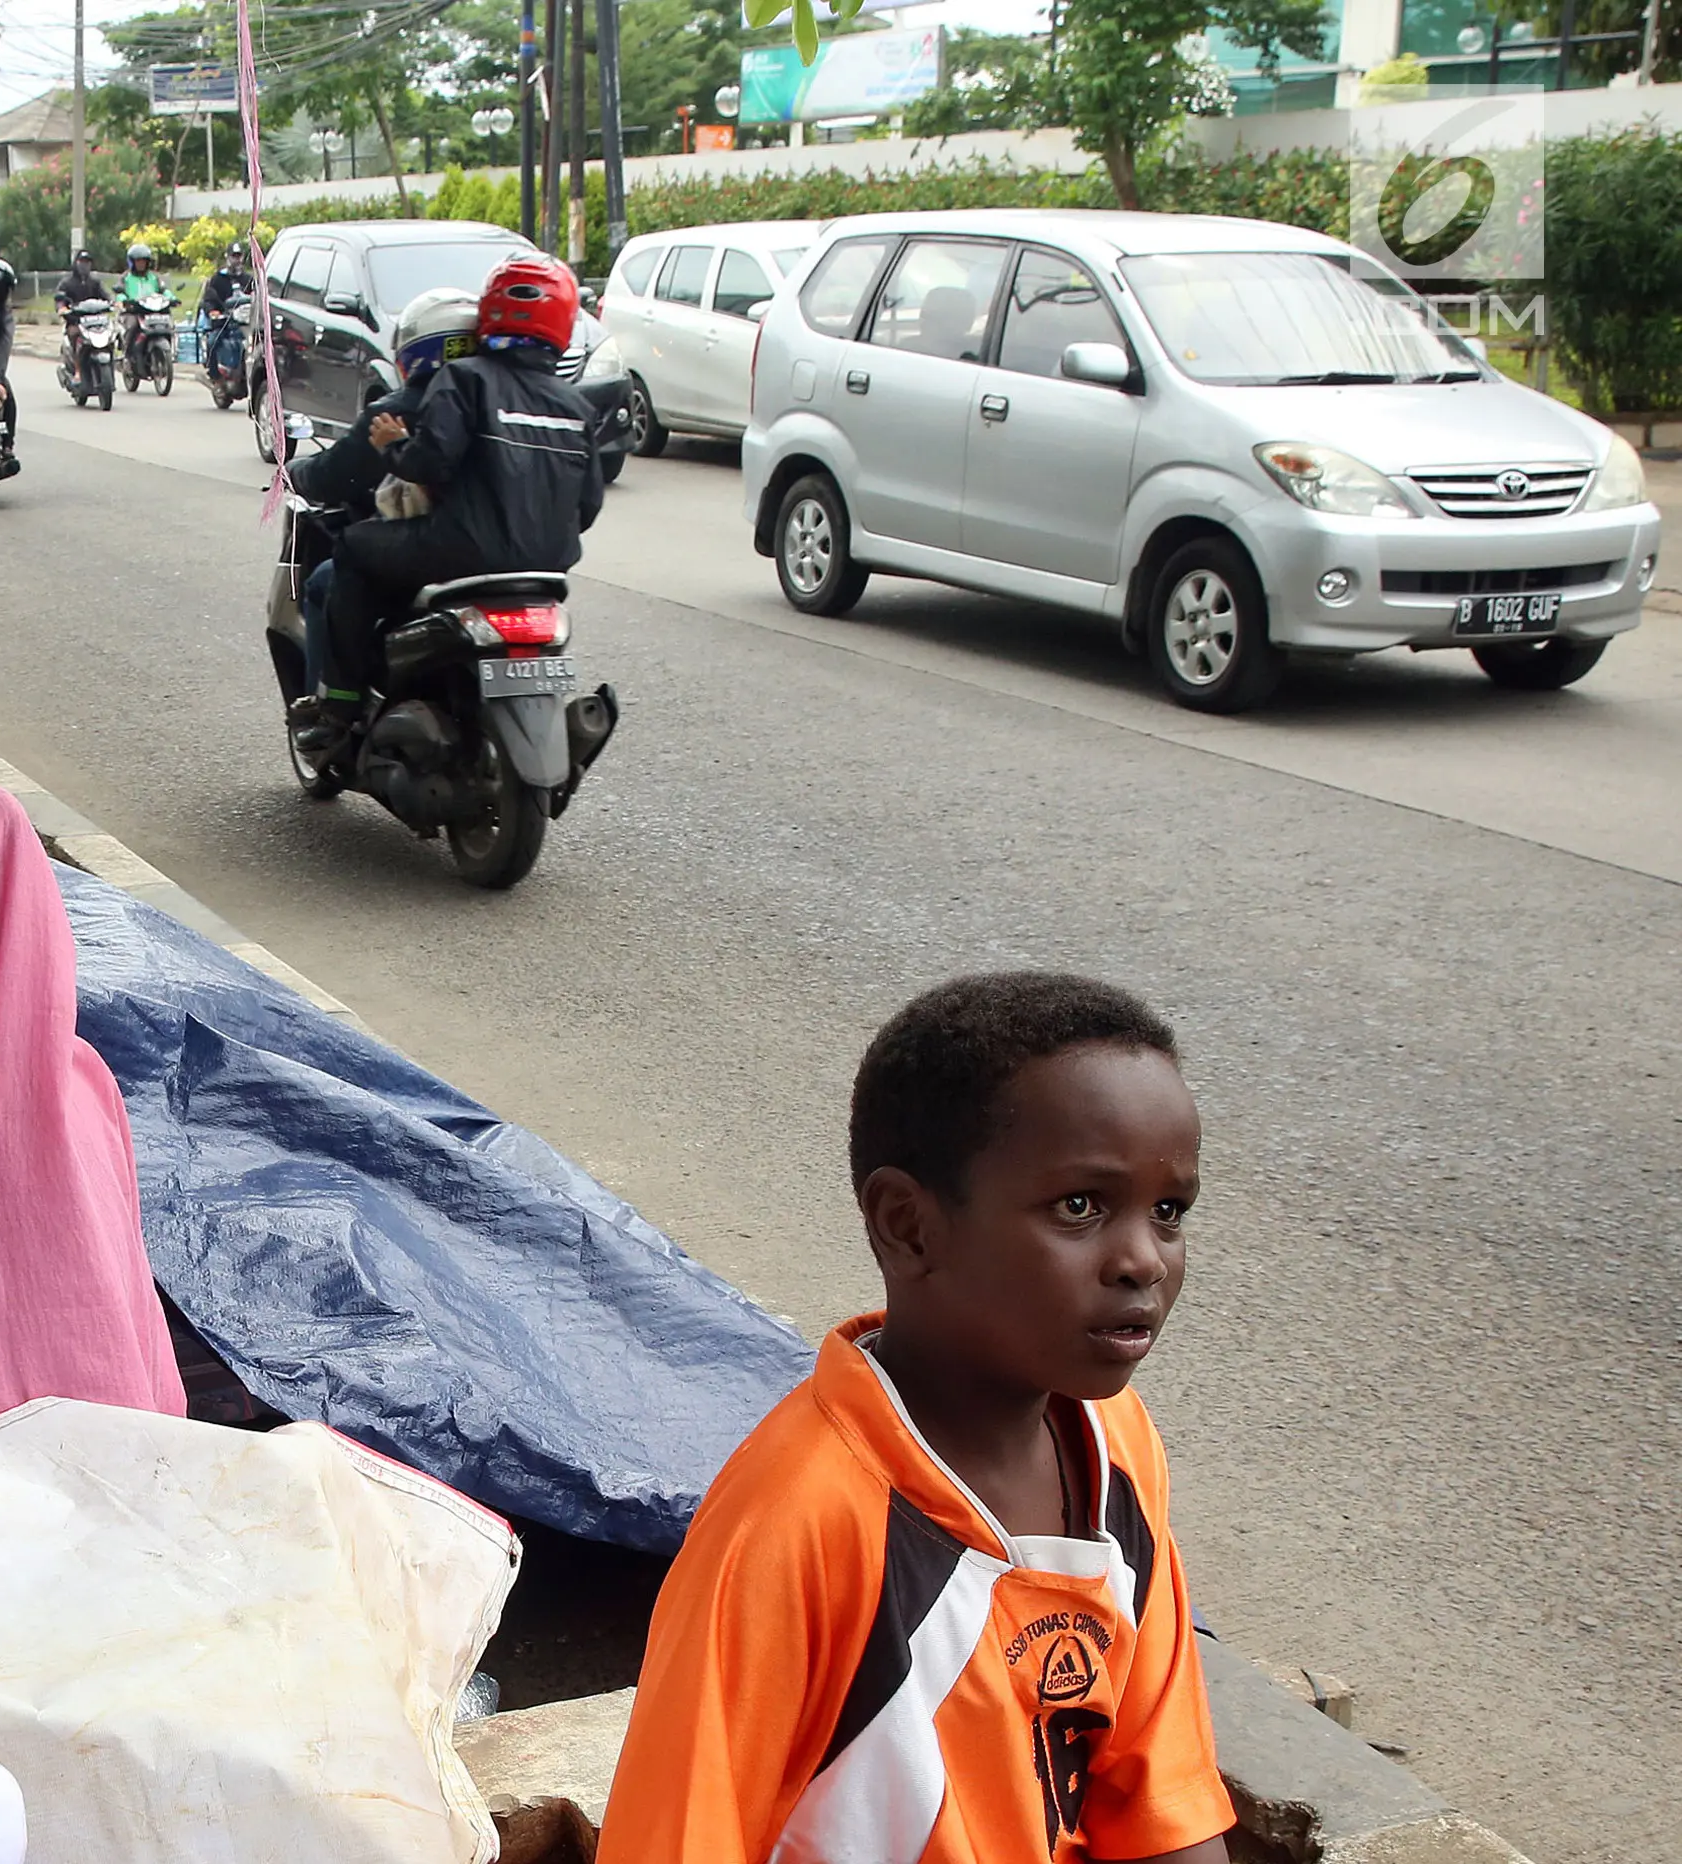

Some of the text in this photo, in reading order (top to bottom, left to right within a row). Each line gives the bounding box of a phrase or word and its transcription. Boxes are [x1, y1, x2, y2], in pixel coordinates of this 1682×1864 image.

[1460, 598, 1473, 623] B
[1486, 597, 1525, 622] 1602
[482, 663, 494, 681] B
[505, 660, 539, 679] 4127
[1005, 1632, 1028, 1666] SSB
[1024, 1612, 1070, 1642] TUNAS
[1046, 1674, 1086, 1691] adidas
